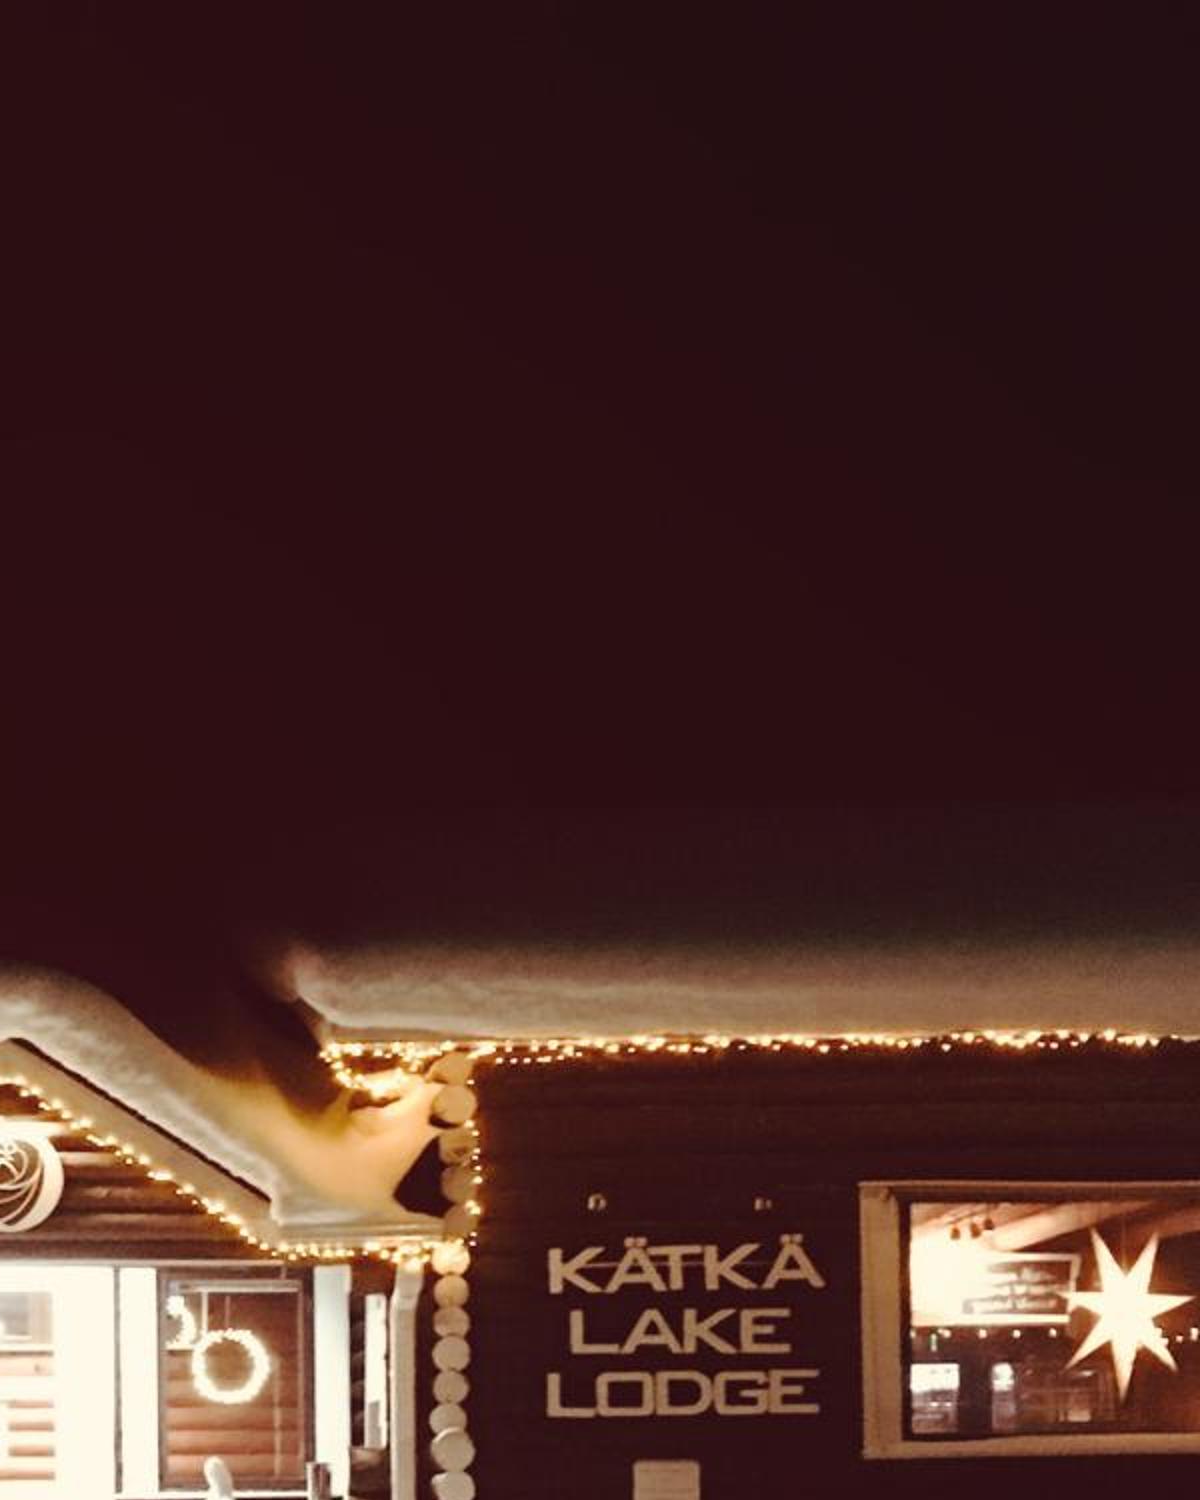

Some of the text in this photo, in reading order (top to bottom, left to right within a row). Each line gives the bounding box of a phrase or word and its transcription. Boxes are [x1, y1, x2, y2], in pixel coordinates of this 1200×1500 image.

[547, 1234, 826, 1295] KÄTKÄ
[569, 1308, 791, 1355] LAKE
[546, 1369, 820, 1419] LODGE
